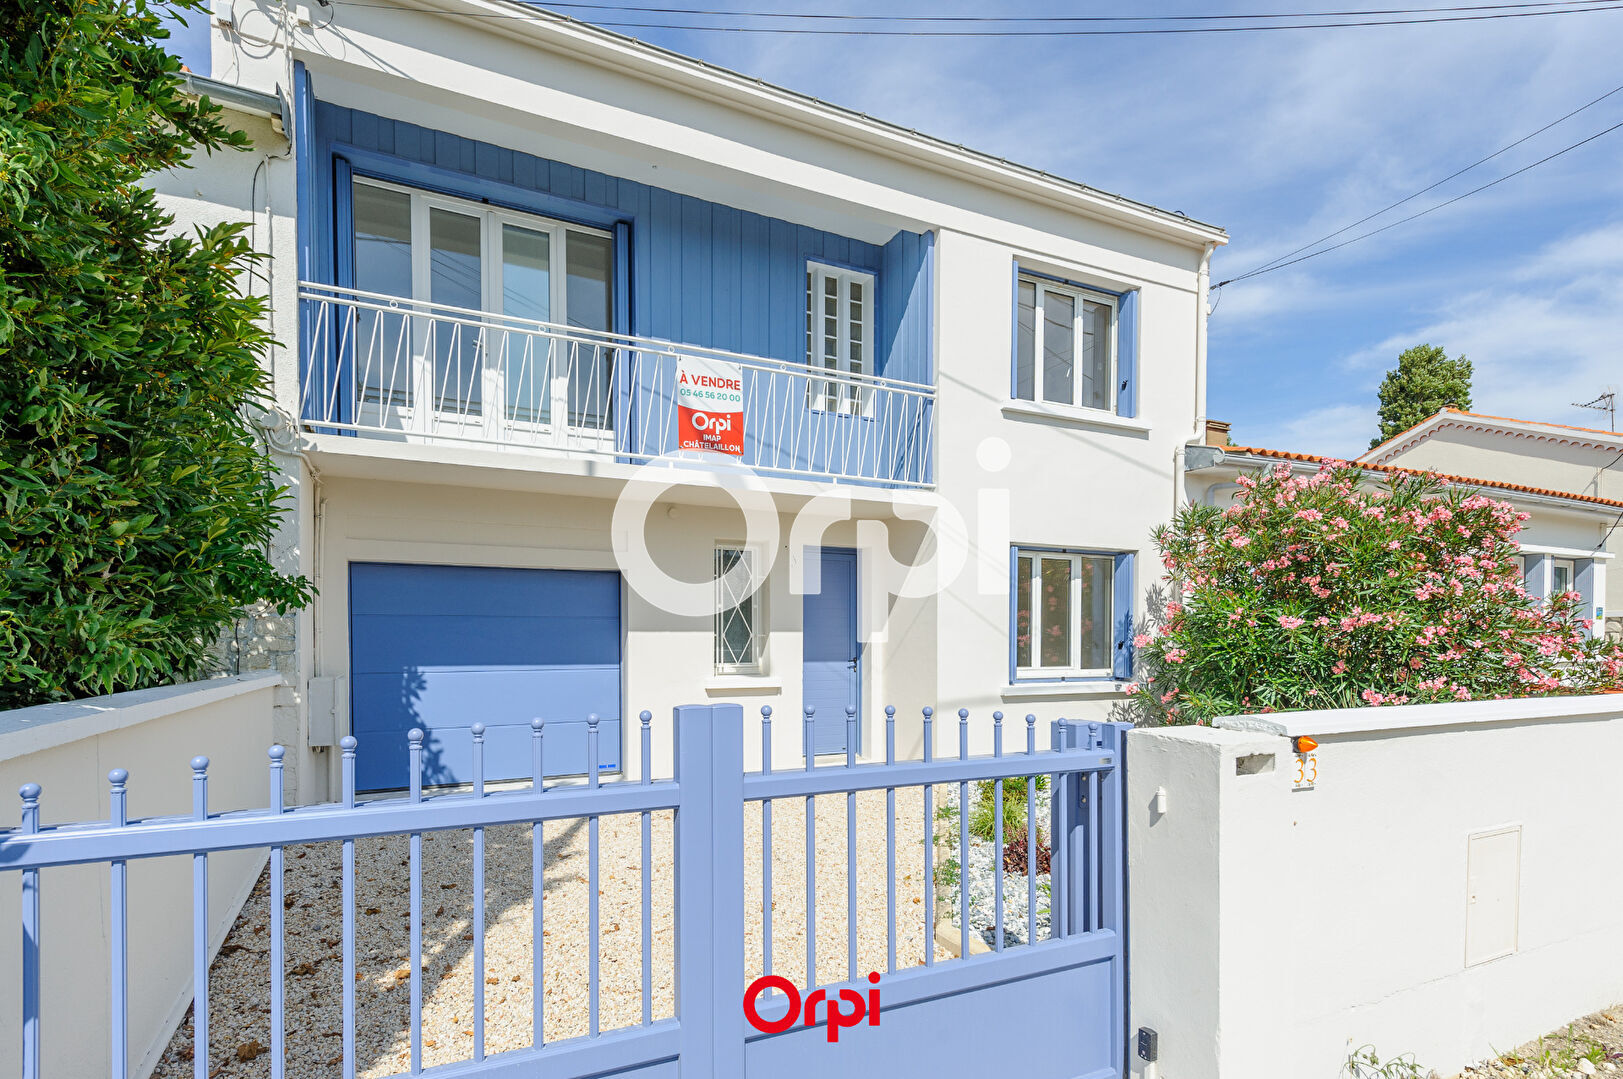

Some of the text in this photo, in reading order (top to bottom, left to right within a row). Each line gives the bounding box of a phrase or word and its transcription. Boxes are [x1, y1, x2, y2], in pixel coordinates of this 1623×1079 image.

[680, 370, 741, 390] À VENDRE
[680, 388, 741, 402] 05 46 56 20 00
[691, 412, 731, 434] Orpi
[683, 440, 741, 452] CHÂTELAILLON
[703, 434, 721, 442] IMAP
[1294, 758, 1317, 783] 33
